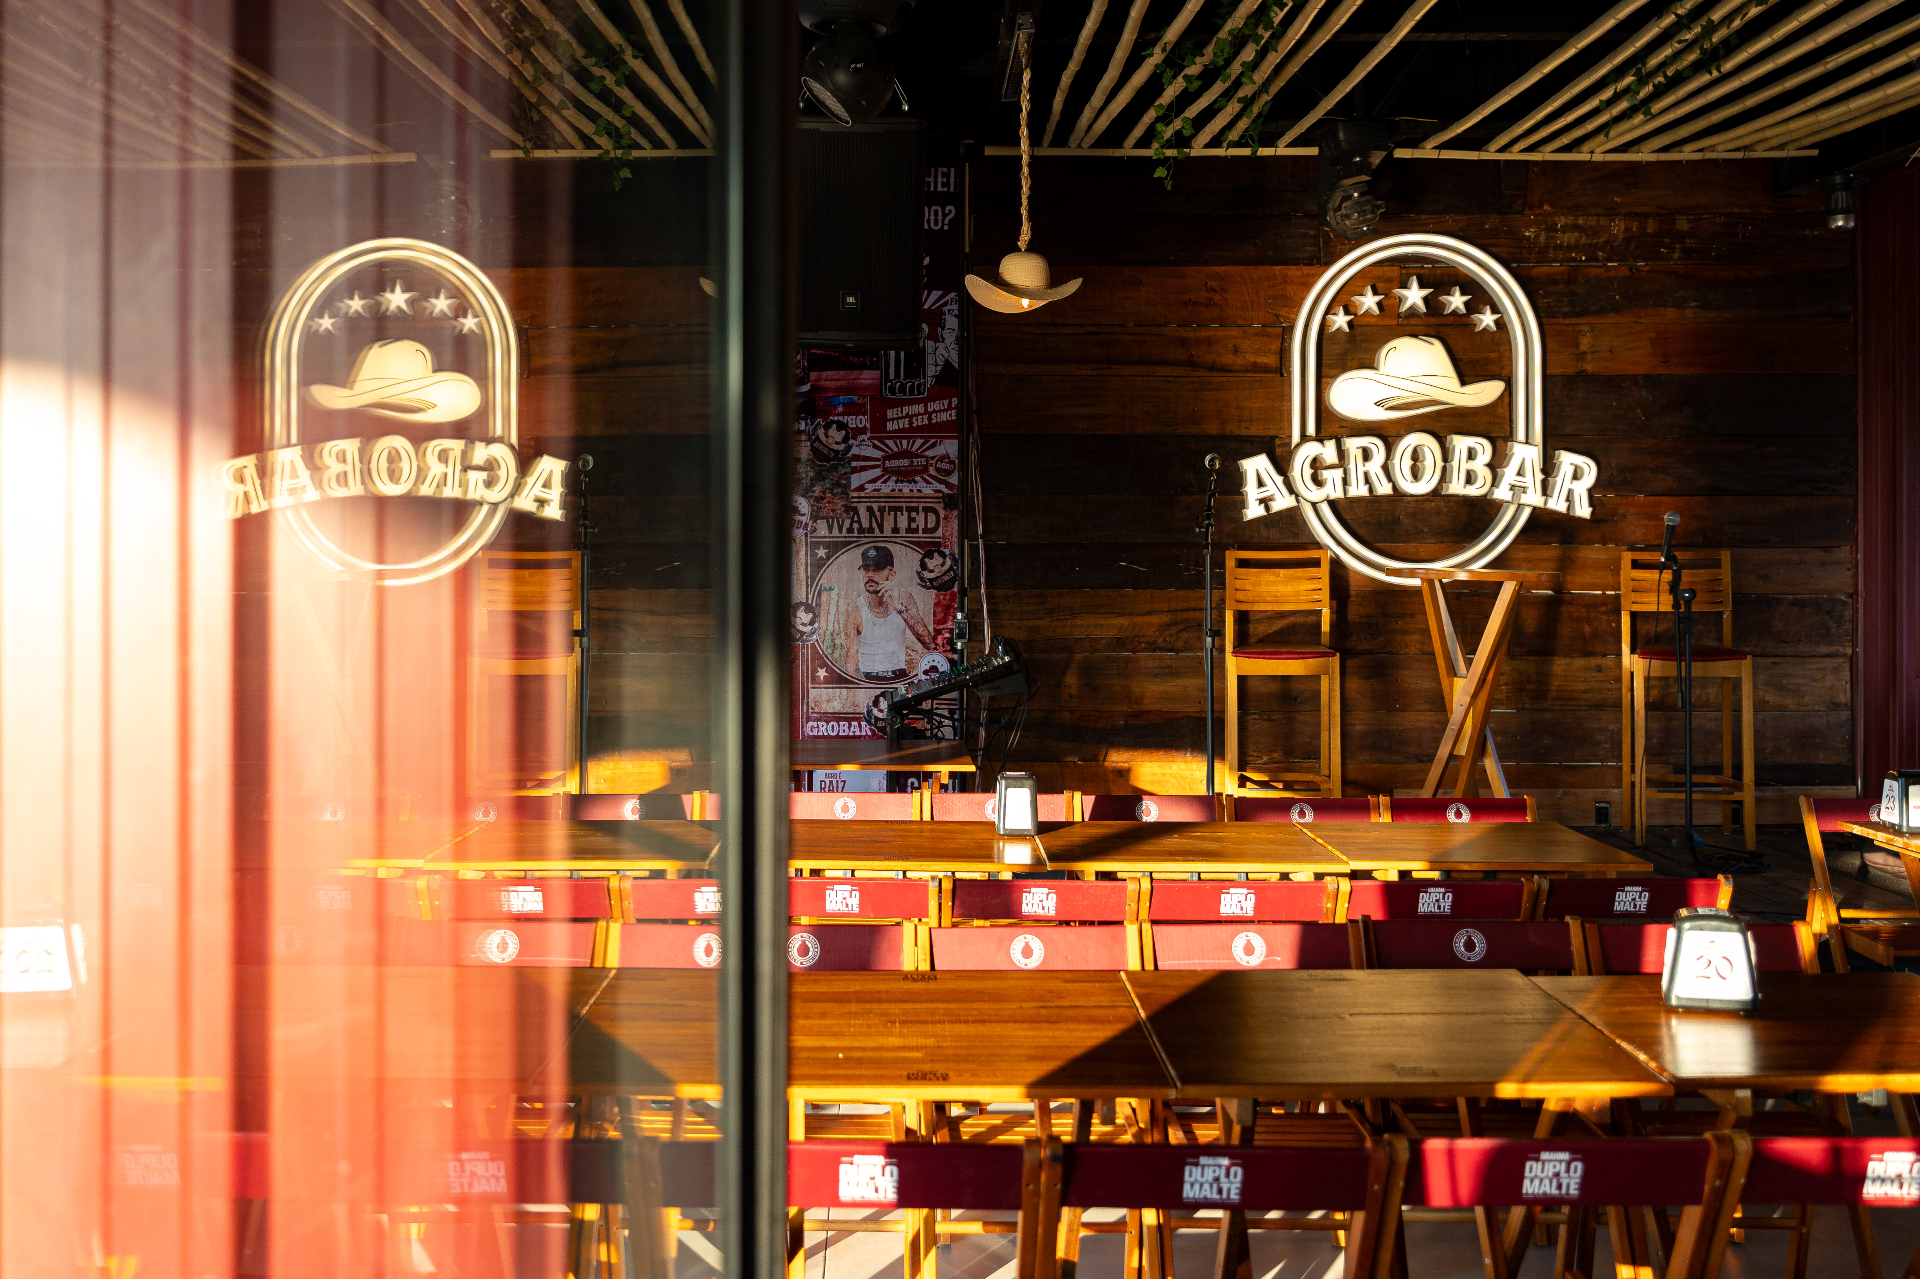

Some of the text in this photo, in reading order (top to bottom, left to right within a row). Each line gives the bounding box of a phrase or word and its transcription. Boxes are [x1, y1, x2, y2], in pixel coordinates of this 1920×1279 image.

[925, 167, 959, 192] HEI
[886, 404, 925, 419] HELPING
[927, 399, 949, 412] UGLY
[886, 409, 957, 432] HAVE SEX SINCE
[1237, 432, 1598, 521] AGROBAR
[826, 505, 941, 535] WANTED
[806, 721, 872, 736] GROBAR
[1885, 793, 1896, 811] 23
[826, 890, 859, 900] DUPLO
[1022, 893, 1056, 903] DUPLO
[1221, 894, 1255, 903] DUPLO
[1419, 893, 1452, 903] DUPLO
[1615, 892, 1649, 901] DUPLO
[826, 900, 859, 911] MALTE
[1022, 903, 1056, 913] MALTE
[1220, 903, 1254, 914] MALTE
[1418, 902, 1451, 912] MALTE
[1614, 901, 1648, 911] MALTE
[1695, 955, 1733, 980] 20
[839, 1164, 899, 1181] DUPLO
[1184, 1165, 1243, 1182] DUPLO
[1525, 1161, 1583, 1178] DUPLO
[1867, 1161, 1920, 1178] DUPLO
[839, 1181, 898, 1198] MALTE
[1183, 1182, 1241, 1199] MALTE
[1522, 1178, 1580, 1194] MALTE
[1863, 1178, 1919, 1194] MALTE
